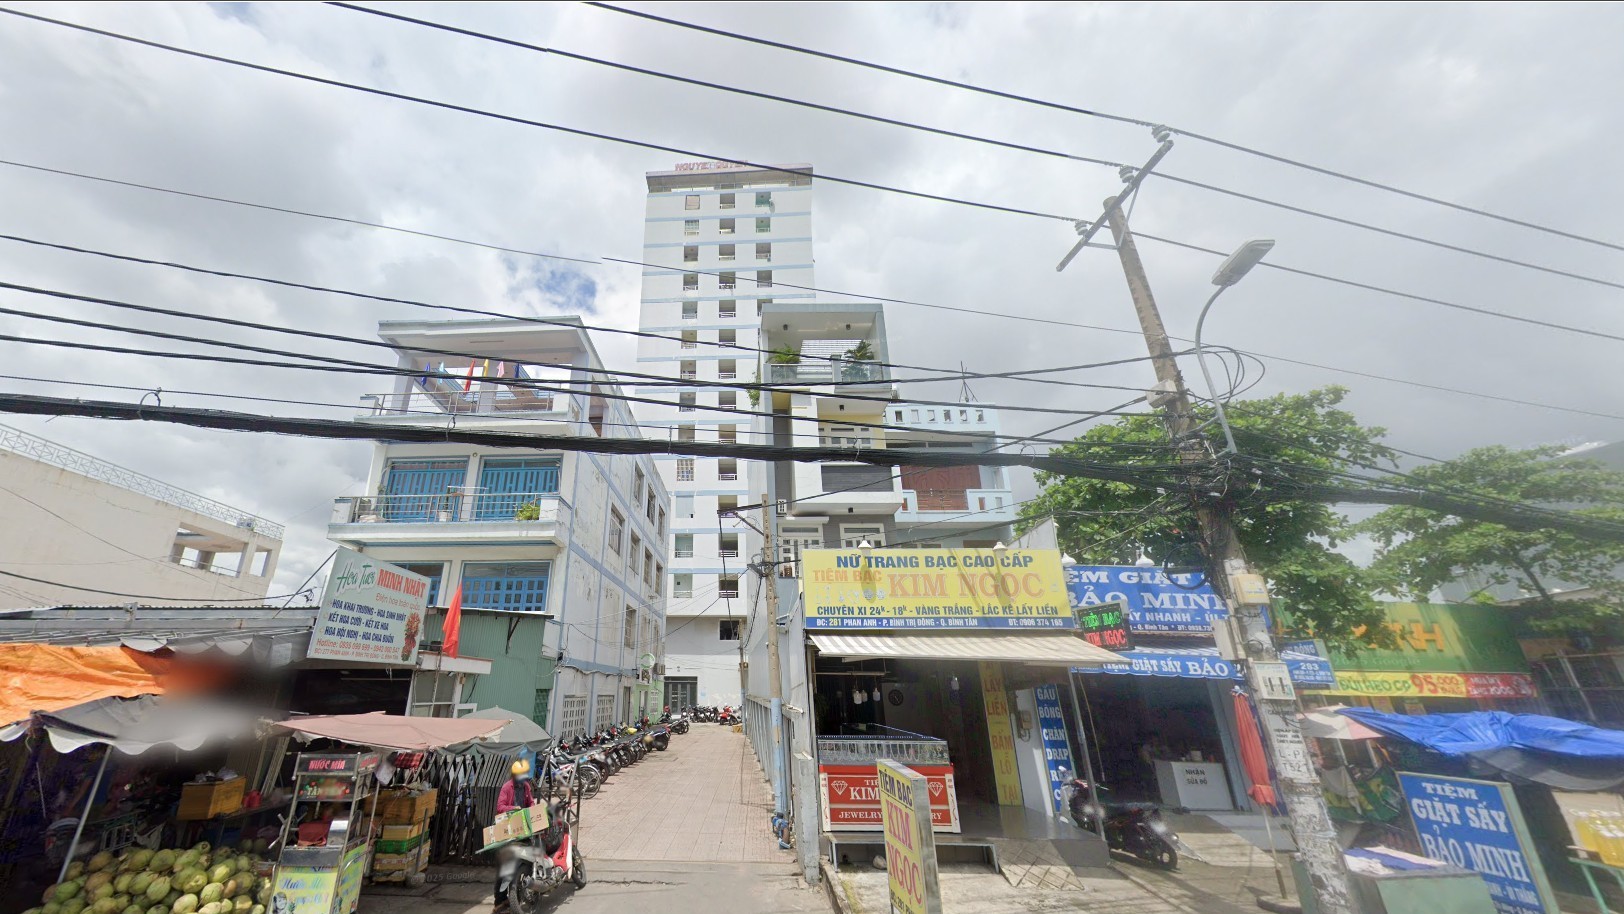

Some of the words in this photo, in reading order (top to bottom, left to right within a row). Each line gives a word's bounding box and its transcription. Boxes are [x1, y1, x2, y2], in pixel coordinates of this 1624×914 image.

[836, 554, 861, 568] NỮ
[865, 556, 919, 568] TRANG
[925, 555, 958, 570] BẠC
[962, 555, 995, 568] CAO
[1000, 552, 1033, 568] CẤP
[377, 568, 403, 592] MINH
[403, 578, 427, 600] NHẬT
[888, 573, 949, 598] KIM
[958, 572, 1045, 602] NGỌC
[817, 604, 854, 616] CHUYÊN
[857, 606, 867, 616] XI
[915, 604, 940, 616] VÀNG
[1146, 612, 1191, 622] NHANH
[829, 618, 841, 627] 281
[843, 618, 861, 627] PHAN
[863, 618, 877, 627] ANH
[889, 617, 905, 627] BÌNH
[948, 617, 964, 627] BÌNH
[1132, 657, 1159, 674] GIẶT
[1161, 657, 1182, 673] SẤY
[1185, 657, 1229, 677] BẢO
[1045, 748, 1069, 760] DRAP
[849, 787, 880, 801] KIM
[1421, 781, 1479, 801] TIỆM
[839, 811, 883, 819] JEWELRY
[1410, 796, 1462, 828] GIẶT
[1464, 801, 1509, 833] SẤY
[886, 799, 913, 851] KIM
[1421, 824, 1466, 868] BẢO
[1465, 841, 1531, 883] MINH
[886, 839, 922, 905] NGỌC
